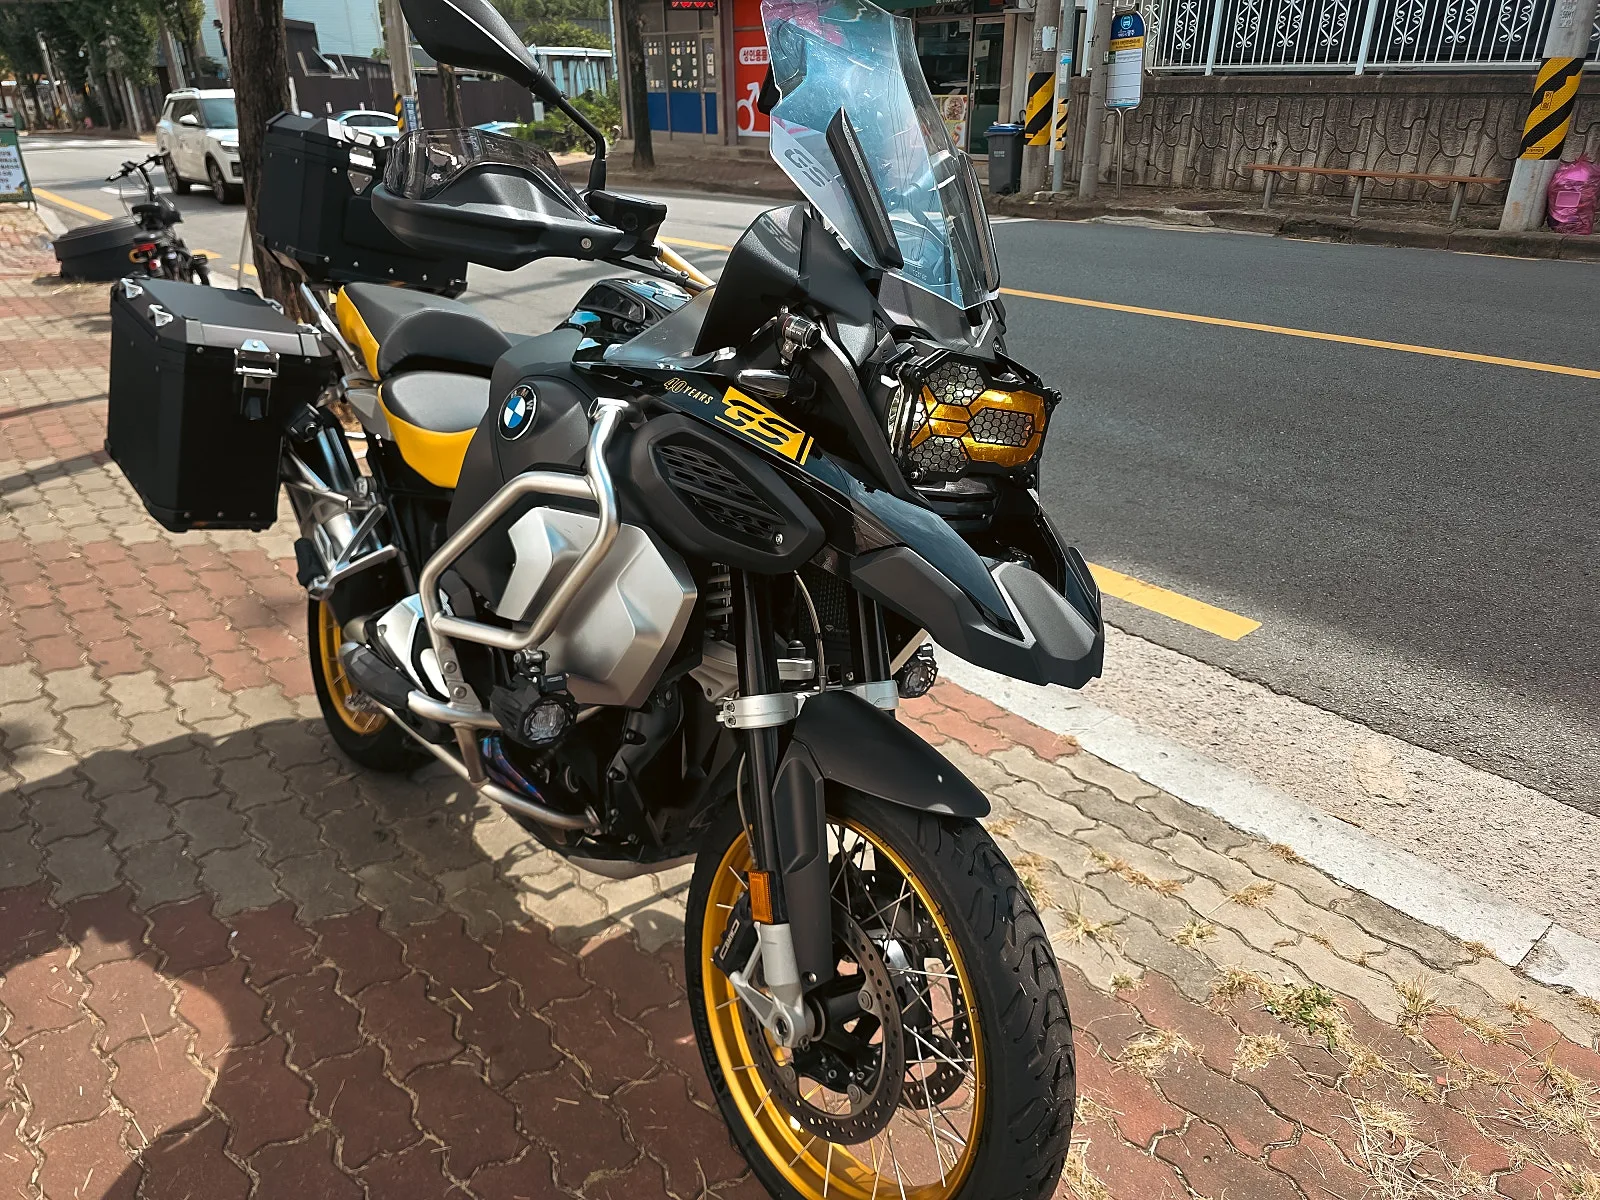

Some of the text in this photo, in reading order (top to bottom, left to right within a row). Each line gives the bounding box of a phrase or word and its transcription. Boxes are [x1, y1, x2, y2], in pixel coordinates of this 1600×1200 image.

[743, 49, 768, 62] 성인용품
[784, 148, 831, 188] GS
[510, 387, 534, 410] BMW
[663, 377, 714, 405] 40 YEARS
[715, 399, 803, 446] GS
